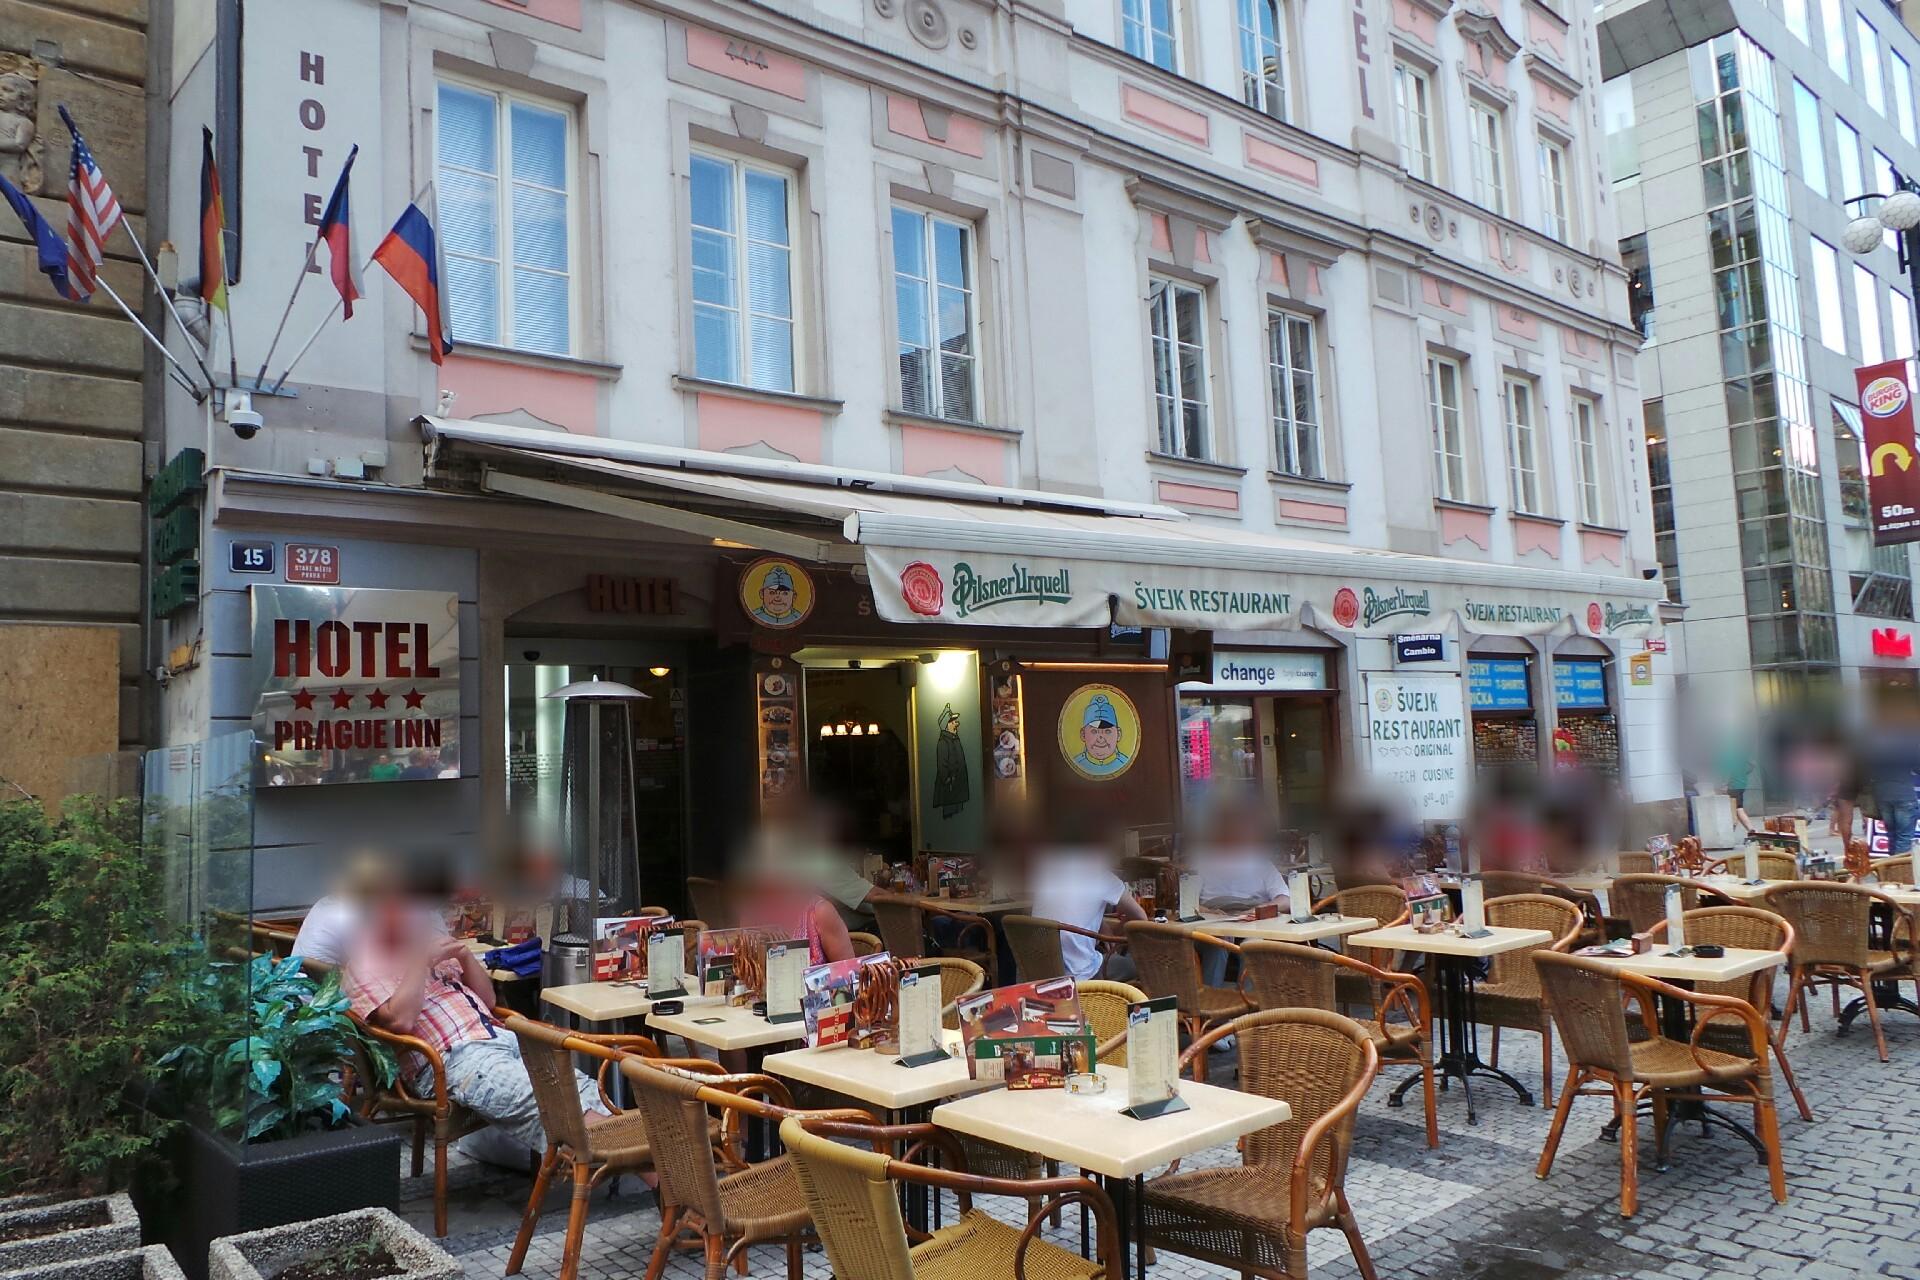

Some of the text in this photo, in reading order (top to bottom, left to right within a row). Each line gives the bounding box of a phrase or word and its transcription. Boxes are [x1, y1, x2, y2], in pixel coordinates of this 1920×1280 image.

[300, 51, 326, 275] HOTEL
[1867, 382, 1900, 401] BURGER
[1869, 388, 1902, 412] KING
[243, 548, 264, 566] 15
[295, 548, 331, 565] 378
[587, 573, 686, 616] HOTEL
[952, 562, 1013, 619] Pilsner
[1011, 562, 1071, 605] Urquell
[1134, 581, 1290, 614] ŠVEJK RESTAURANT
[1363, 585, 1430, 629] Pilsner Urquell
[1465, 599, 1560, 623] ŠVEJK RESTAURANT
[274, 619, 441, 678] HOTEL
[1403, 646, 1436, 656] Cambio
[1221, 663, 1275, 685] change
[1397, 687, 1438, 712] ŠVEJK
[274, 718, 441, 751] PRAGUE INN
[1373, 719, 1462, 740] RESTAURANT
[1414, 744, 1453, 757] ORIGINAL
[1422, 768, 1455, 781] CUISINE
